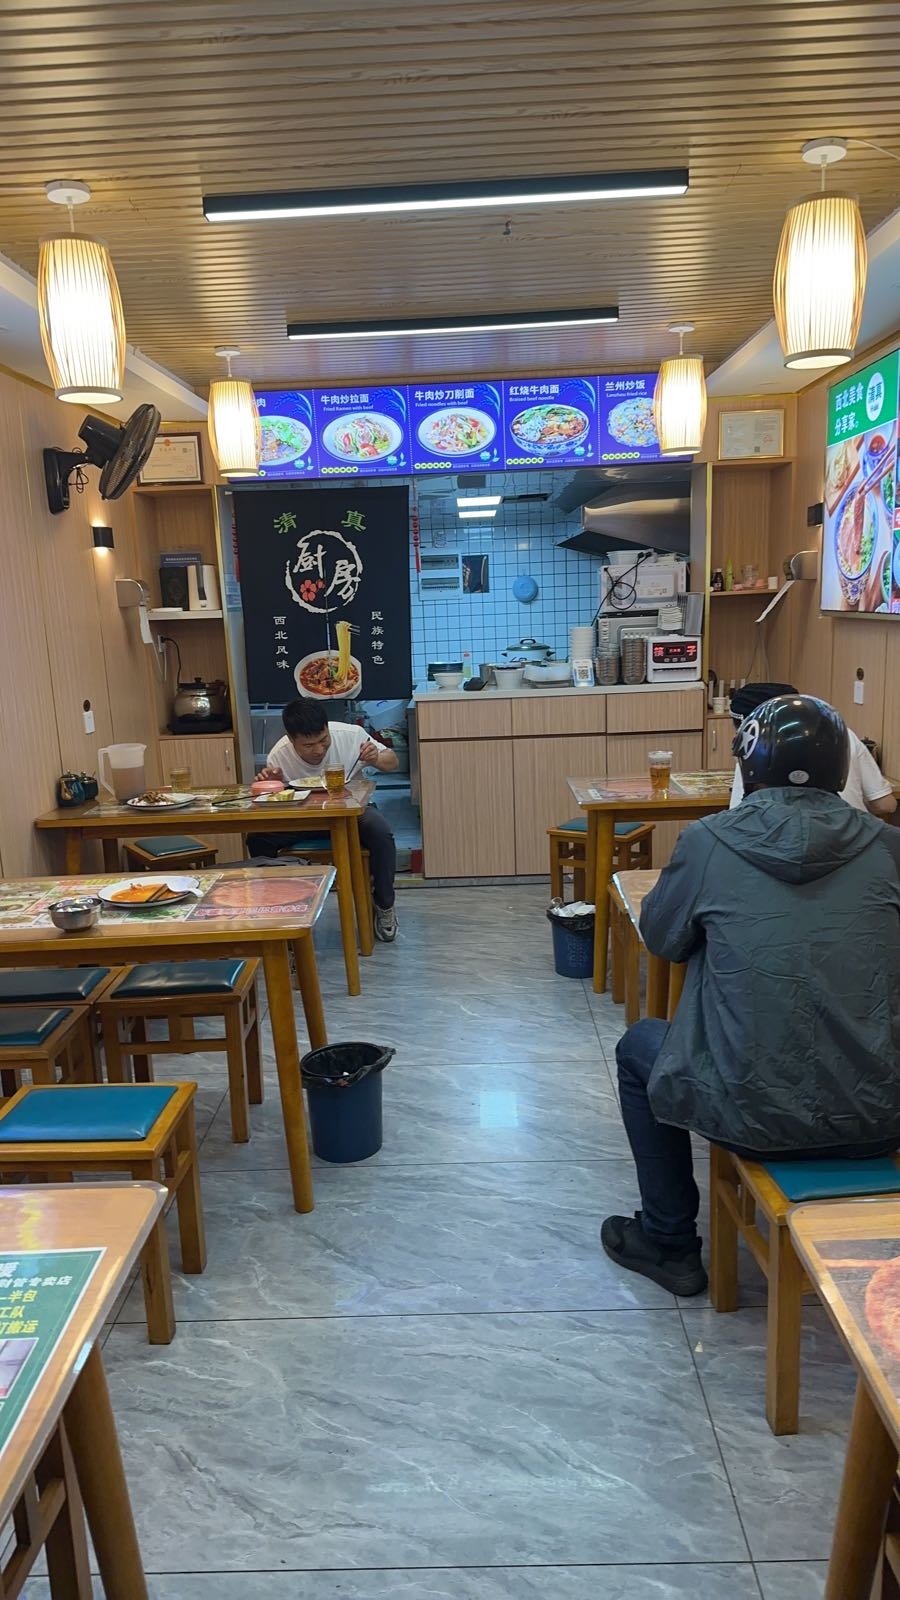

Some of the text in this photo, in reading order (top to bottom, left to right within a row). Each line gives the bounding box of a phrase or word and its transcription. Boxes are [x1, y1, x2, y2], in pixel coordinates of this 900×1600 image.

[414, 388, 475, 401] 牛肉炒刀削面
[509, 384, 560, 396] 红烧牛肉面
[605, 380, 646, 391] 兰州炒饭
[320, 393, 370, 405] 牛肉炒拉面
[835, 382, 864, 412] 西北美食
[293, 541, 362, 600] 厨房
[273, 616, 290, 669] 西北风味
[371, 611, 385, 665] 民族特色
